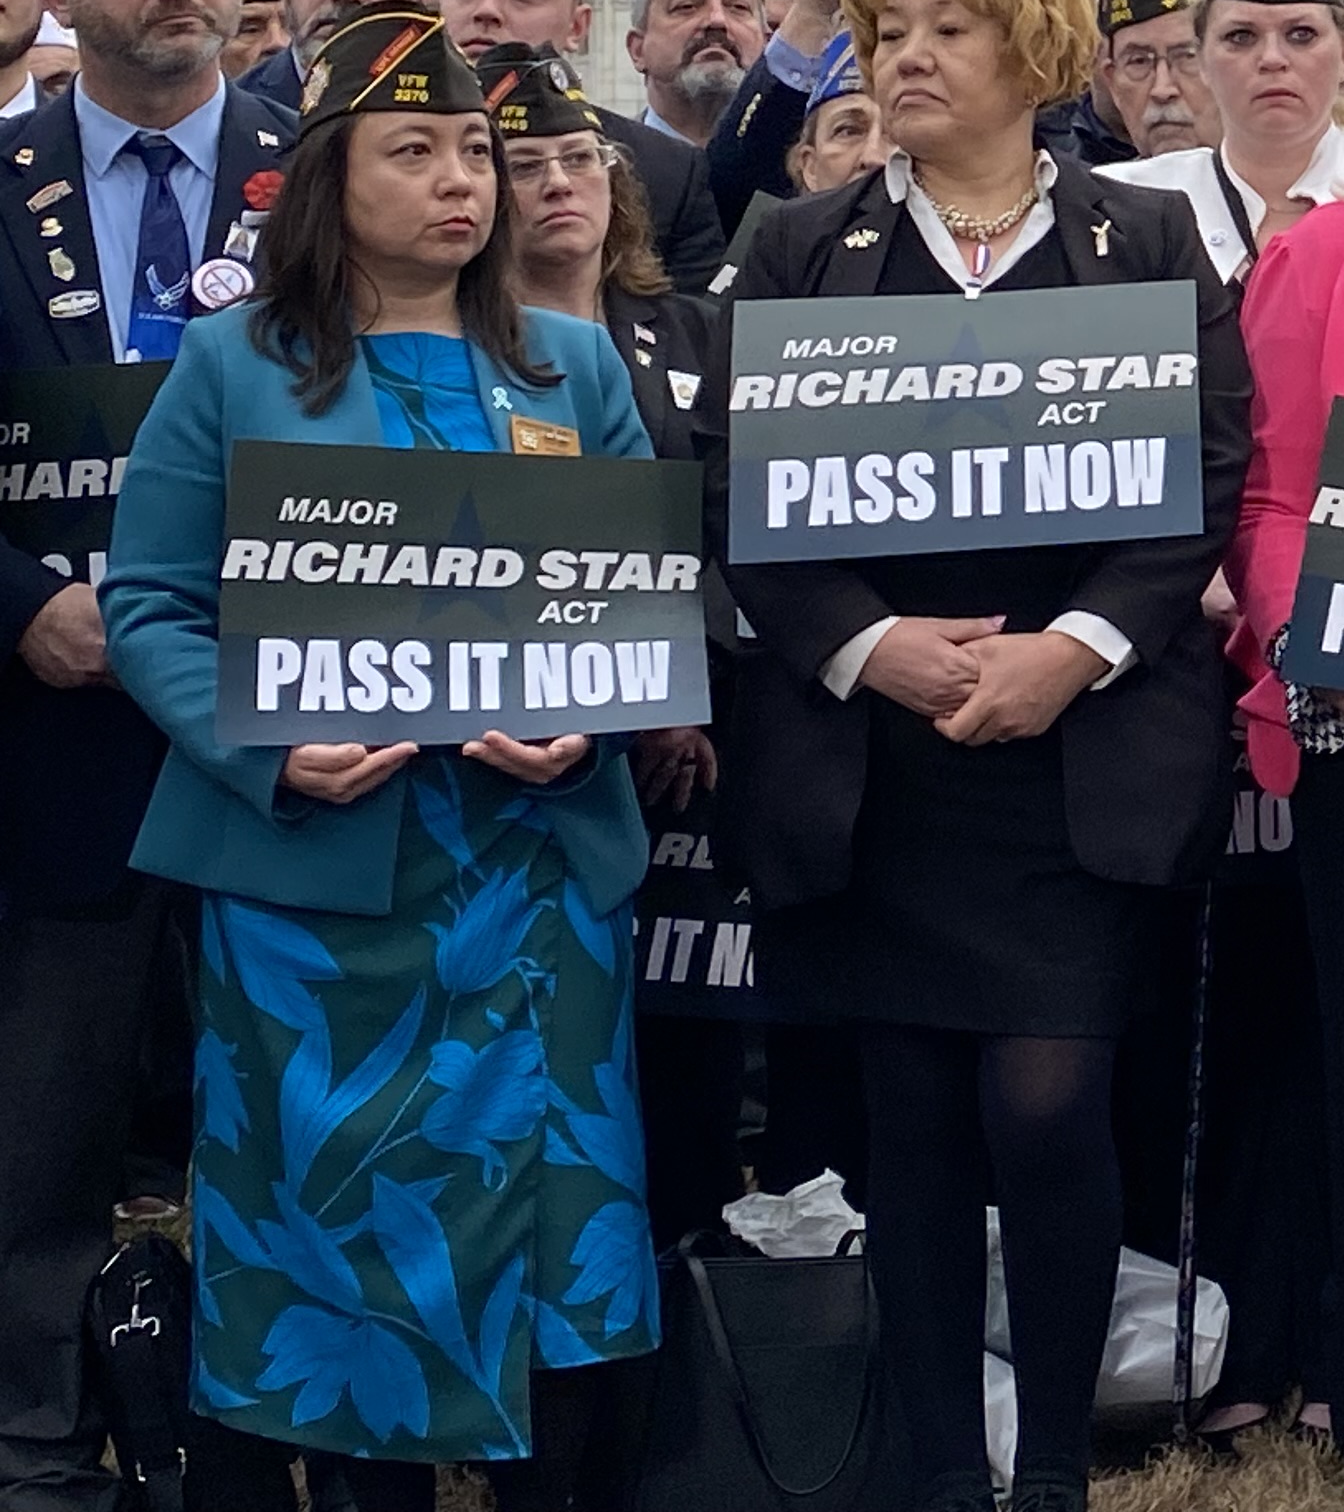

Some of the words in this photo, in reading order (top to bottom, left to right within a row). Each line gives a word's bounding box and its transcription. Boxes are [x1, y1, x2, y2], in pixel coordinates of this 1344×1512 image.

[397, 73, 430, 89] VFW
[782, 335, 897, 359] MAJOR
[728, 362, 1024, 412] RICHARD
[1035, 353, 1199, 396] STAR
[1037, 401, 1106, 427] ACT
[766, 451, 937, 530] PASS
[950, 447, 1009, 518] IT
[1023, 437, 1167, 514] NOW
[278, 497, 398, 526] MAJOR
[220, 539, 524, 589] RICHARD
[536, 549, 701, 592] STAR
[537, 600, 609, 625] ACT
[255, 637, 434, 714] PASS
[448, 641, 509, 712] IT
[523, 639, 671, 710] NOW
[1224, 790, 1295, 853] NO
[645, 916, 705, 983] IT
